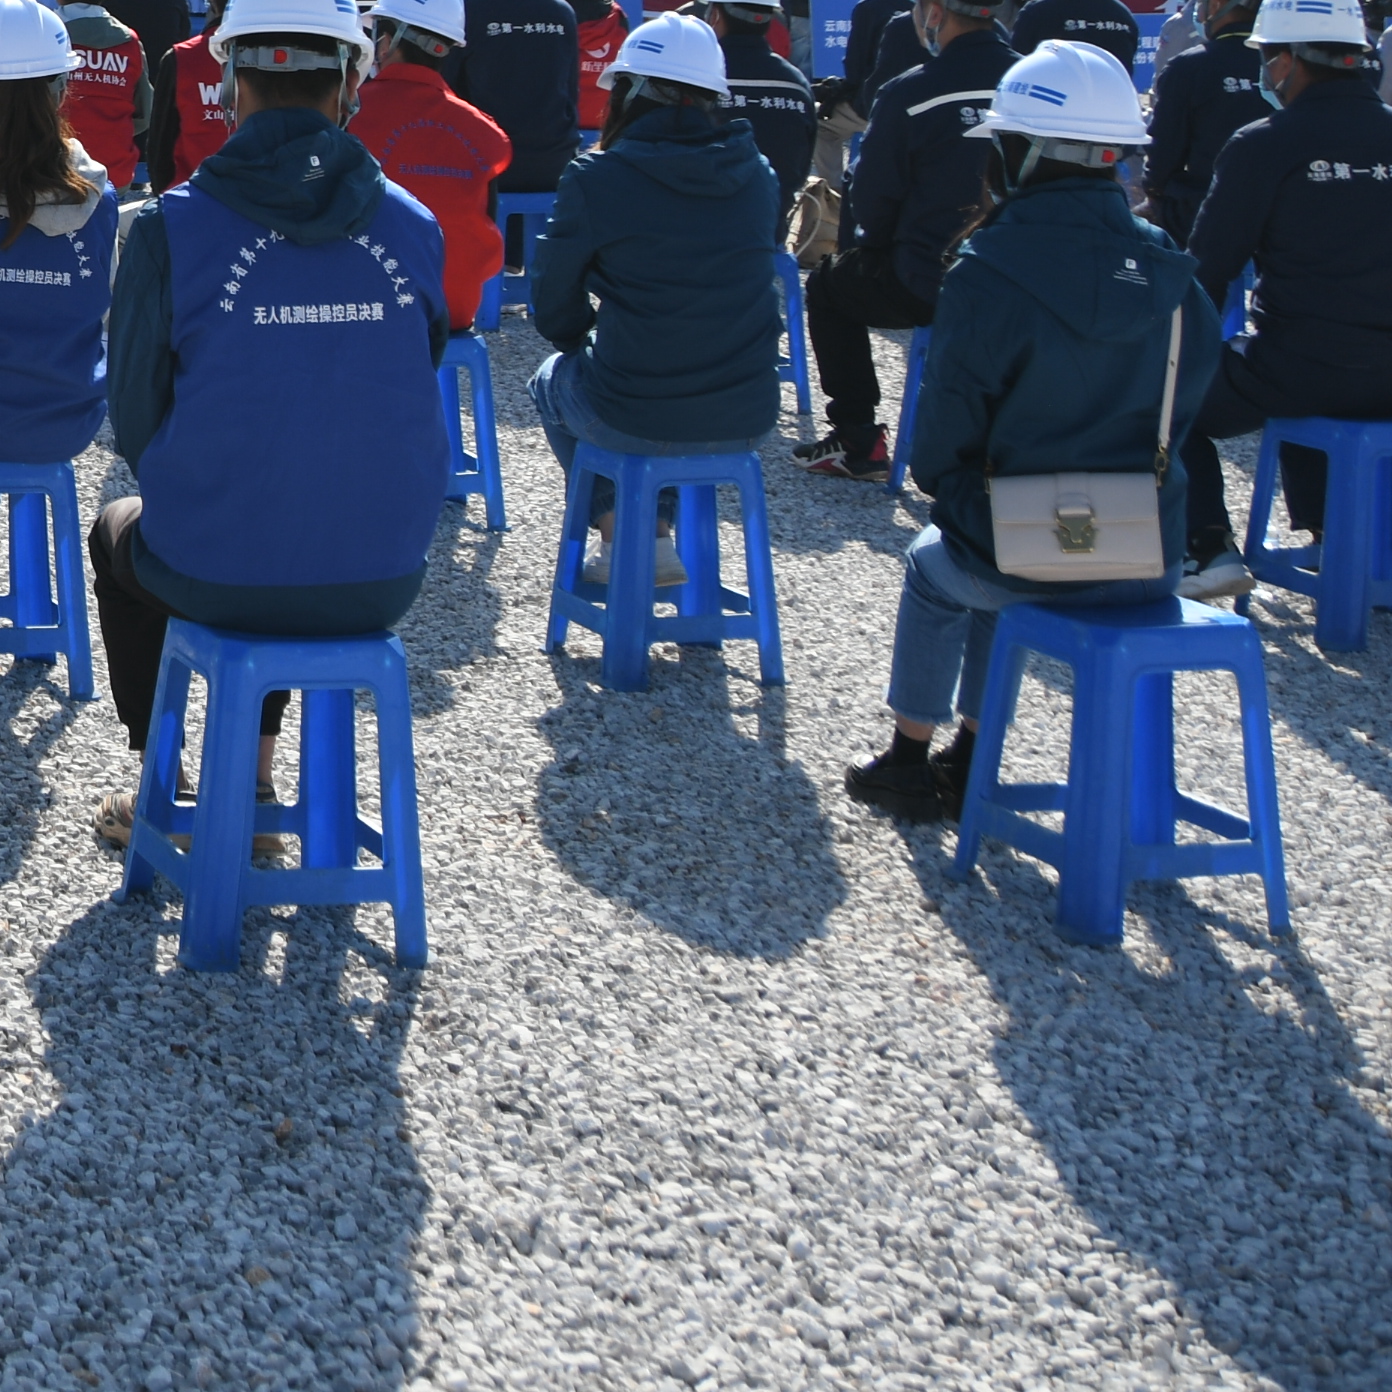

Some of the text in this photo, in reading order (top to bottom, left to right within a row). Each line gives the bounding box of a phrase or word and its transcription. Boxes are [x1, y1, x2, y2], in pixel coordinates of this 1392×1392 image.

[501, 22, 566, 35] 第一水利水电
[734, 94, 806, 113] 第一水利水电
[1333, 161, 1392, 181] 第一水
[253, 302, 384, 325] 无人机测绘操控员决赛
